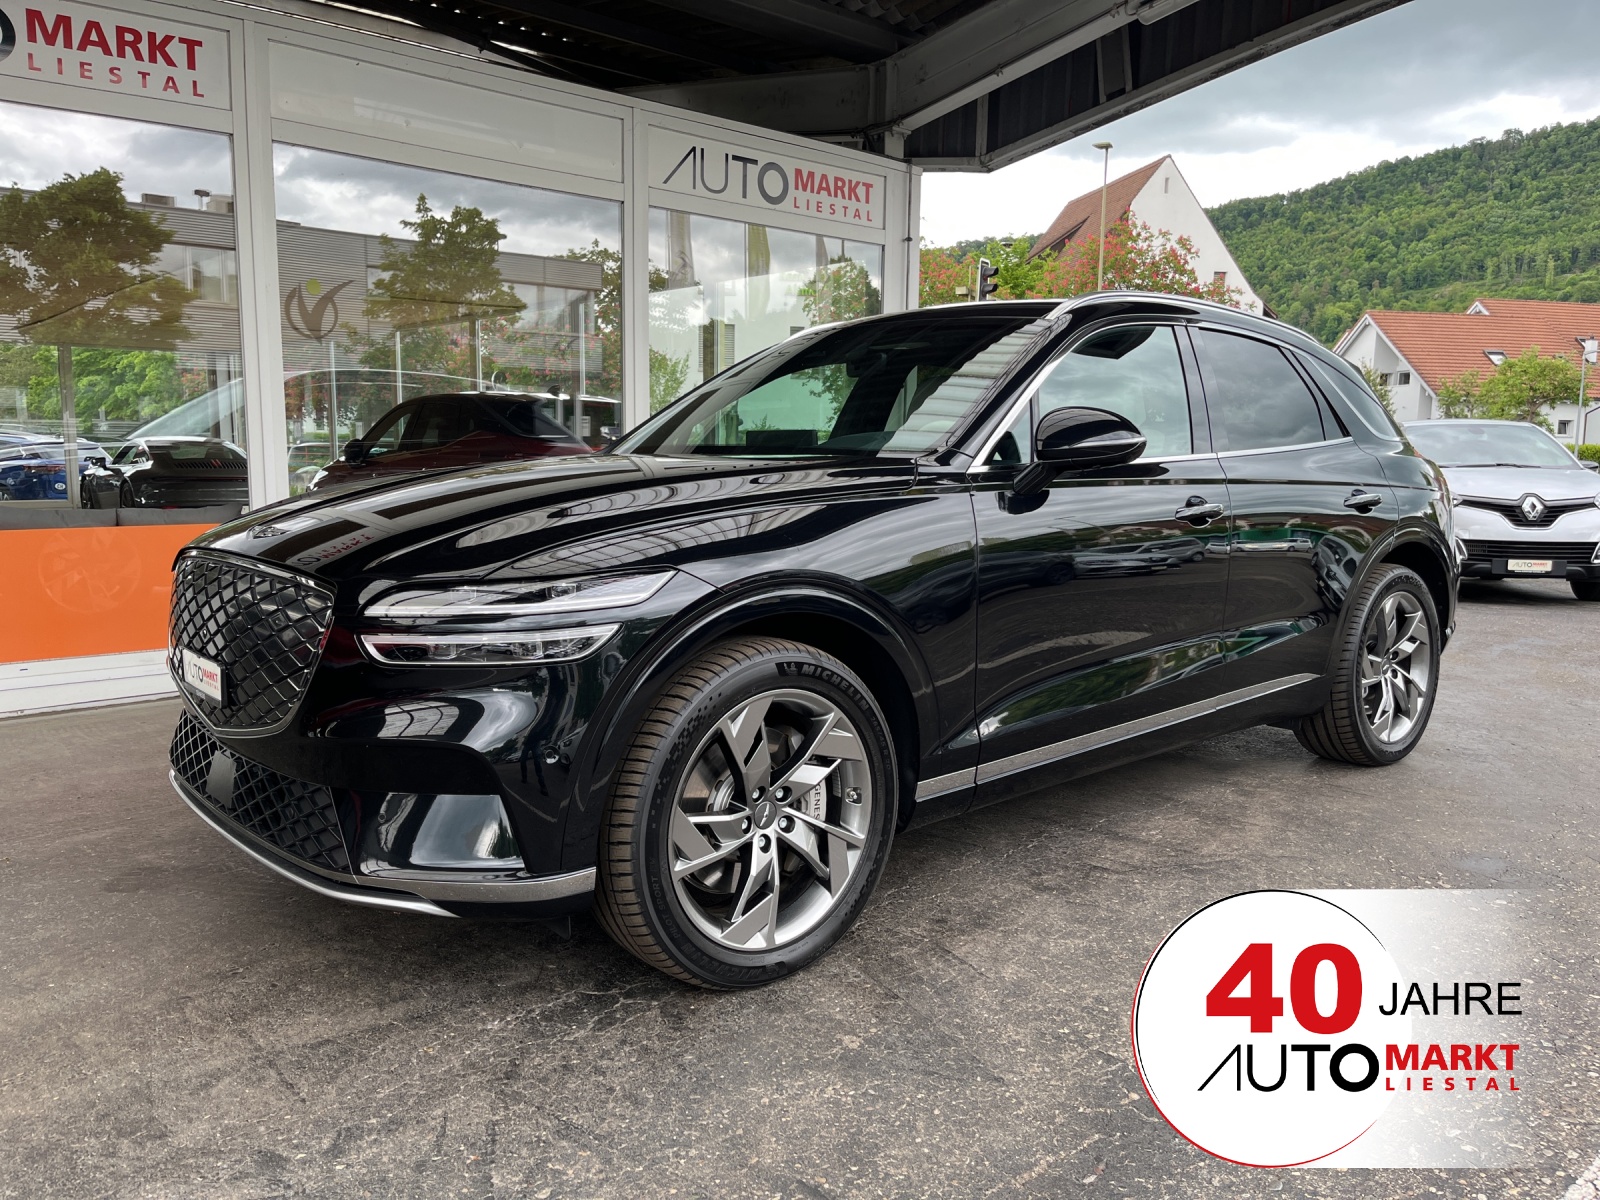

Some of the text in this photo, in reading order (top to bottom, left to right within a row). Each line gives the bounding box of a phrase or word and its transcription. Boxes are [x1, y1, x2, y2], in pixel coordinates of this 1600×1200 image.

[25, 8, 203, 71] MARKT
[27, 53, 205, 98] LIESTAL
[794, 168, 874, 204] MARKT
[793, 196, 873, 222] LIESTAL
[801, 663, 870, 711] MICHELIN
